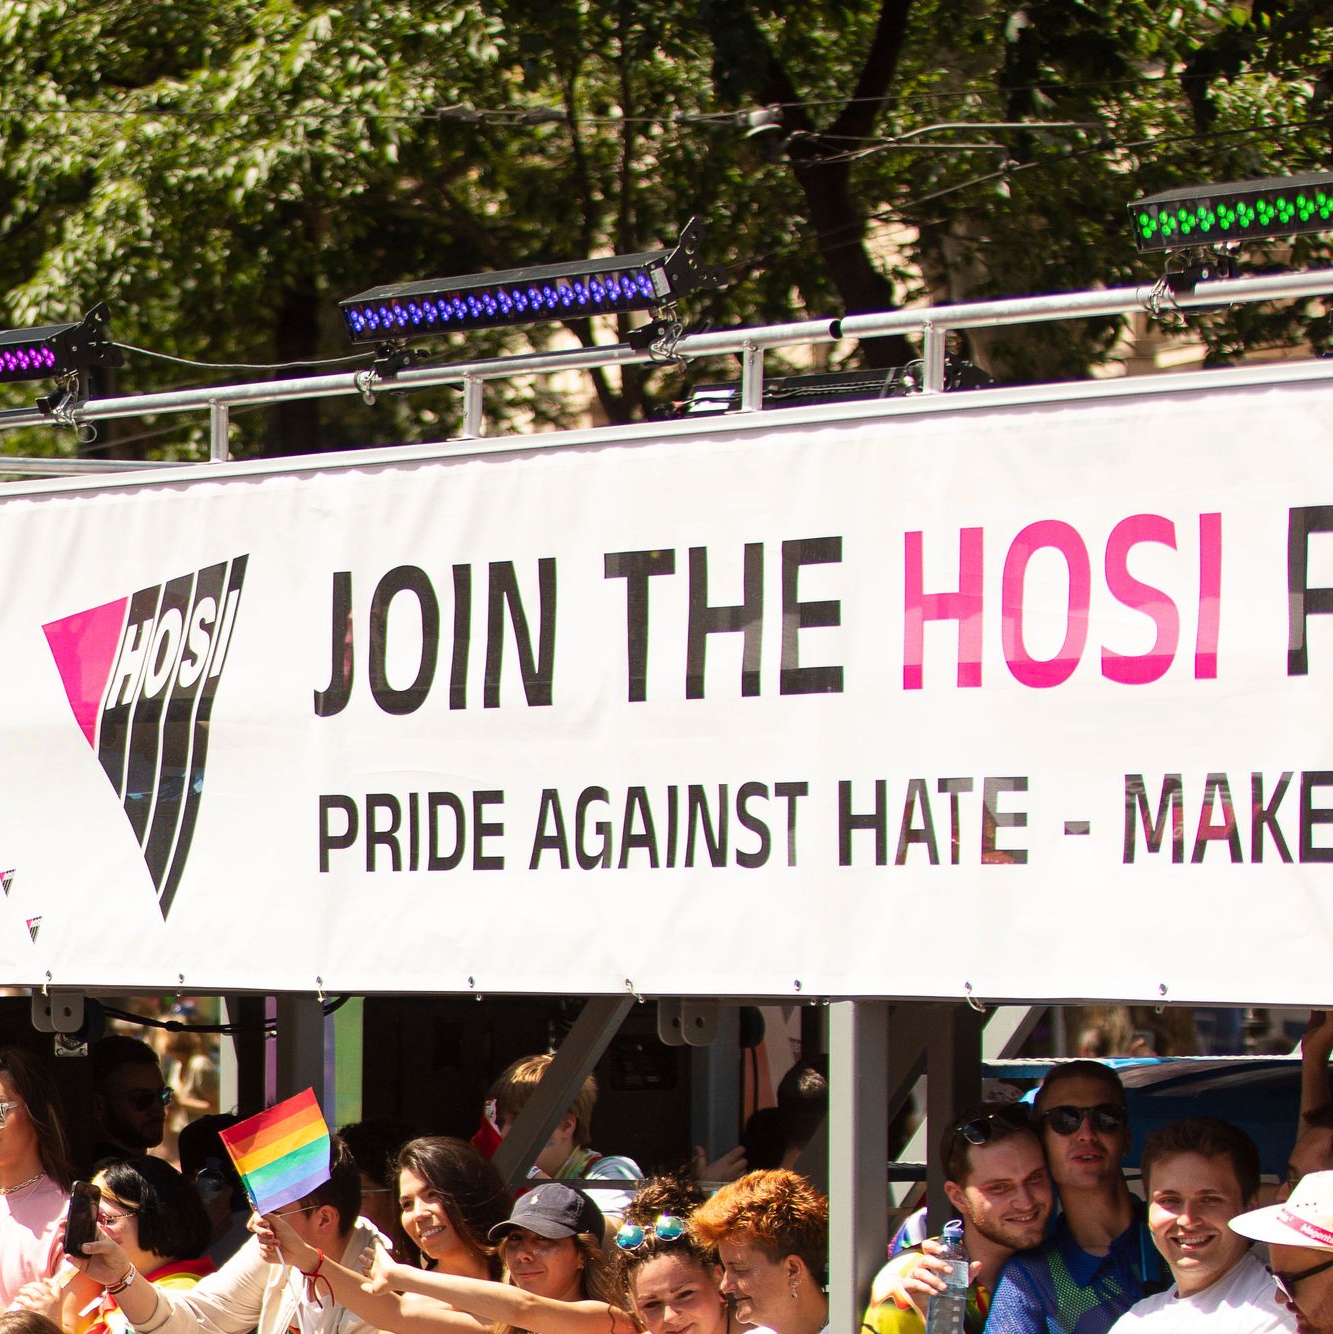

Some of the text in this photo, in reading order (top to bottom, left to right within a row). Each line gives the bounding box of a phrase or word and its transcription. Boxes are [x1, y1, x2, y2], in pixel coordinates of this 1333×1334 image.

[106, 591, 239, 710] HOSI
[313, 556, 558, 717] JOIN
[604, 536, 844, 702] THE
[902, 512, 1222, 690] HOSI
[319, 789, 505, 873] PRIDE
[529, 781, 809, 870] AGAINST
[839, 776, 1029, 867] HATE
[1123, 770, 1333, 865] MAKE
